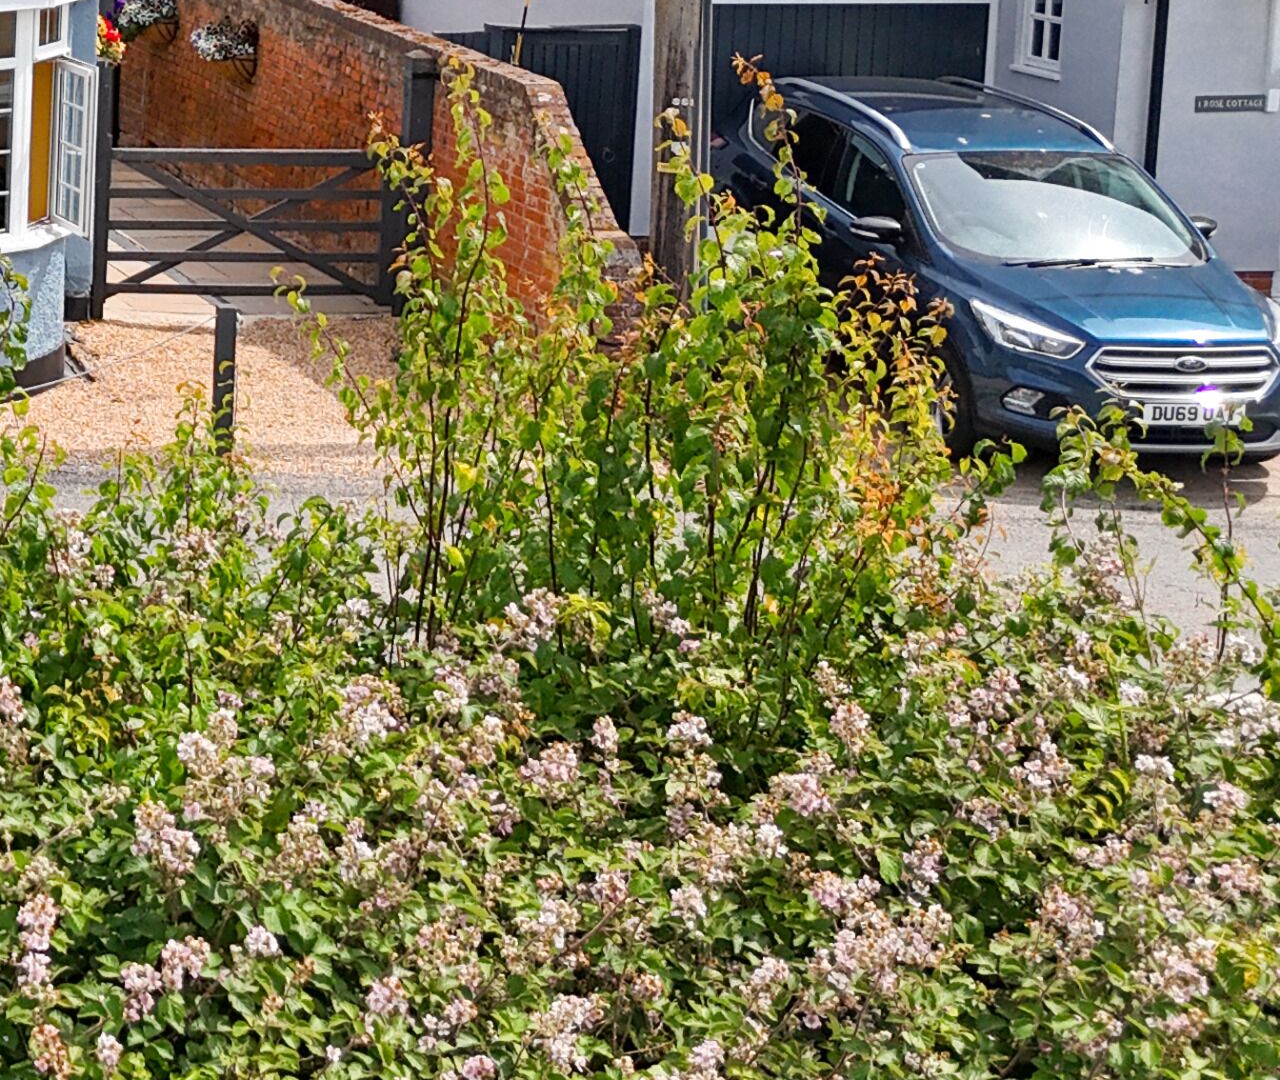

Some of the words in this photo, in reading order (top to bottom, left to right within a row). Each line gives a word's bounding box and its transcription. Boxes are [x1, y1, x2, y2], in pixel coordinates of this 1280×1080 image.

[1203, 99, 1224, 109] ROSE
[1226, 99, 1264, 108] COTTAGE
[1152, 406, 1198, 421] DU69
